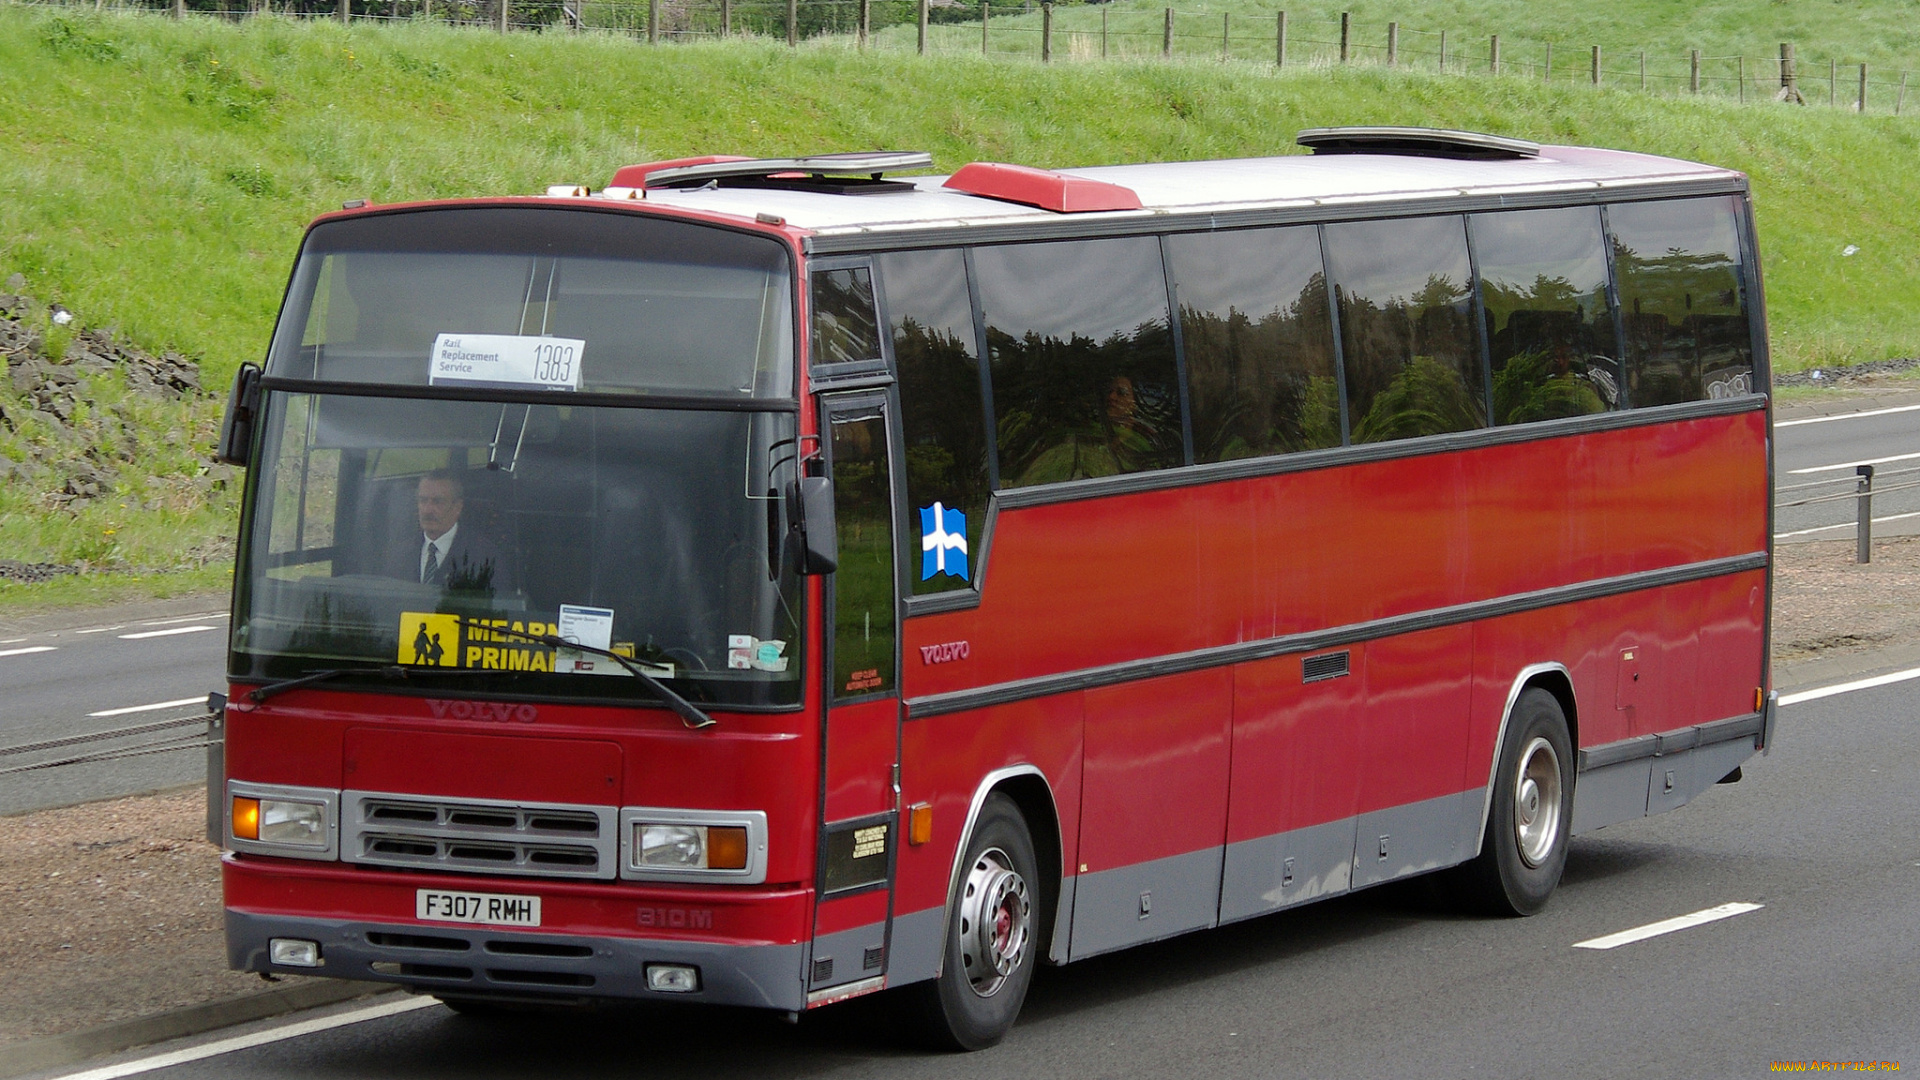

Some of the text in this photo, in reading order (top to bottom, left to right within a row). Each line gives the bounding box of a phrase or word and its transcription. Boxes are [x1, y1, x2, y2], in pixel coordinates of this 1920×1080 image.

[443, 339, 461, 348] Rail
[439, 362, 472, 373] Service
[441, 350, 499, 363] Replacement
[534, 344, 574, 382] 1383
[920, 640, 970, 665] VOLVO
[425, 699, 538, 723] VOLVO
[426, 894, 532, 922] F307 RMH
